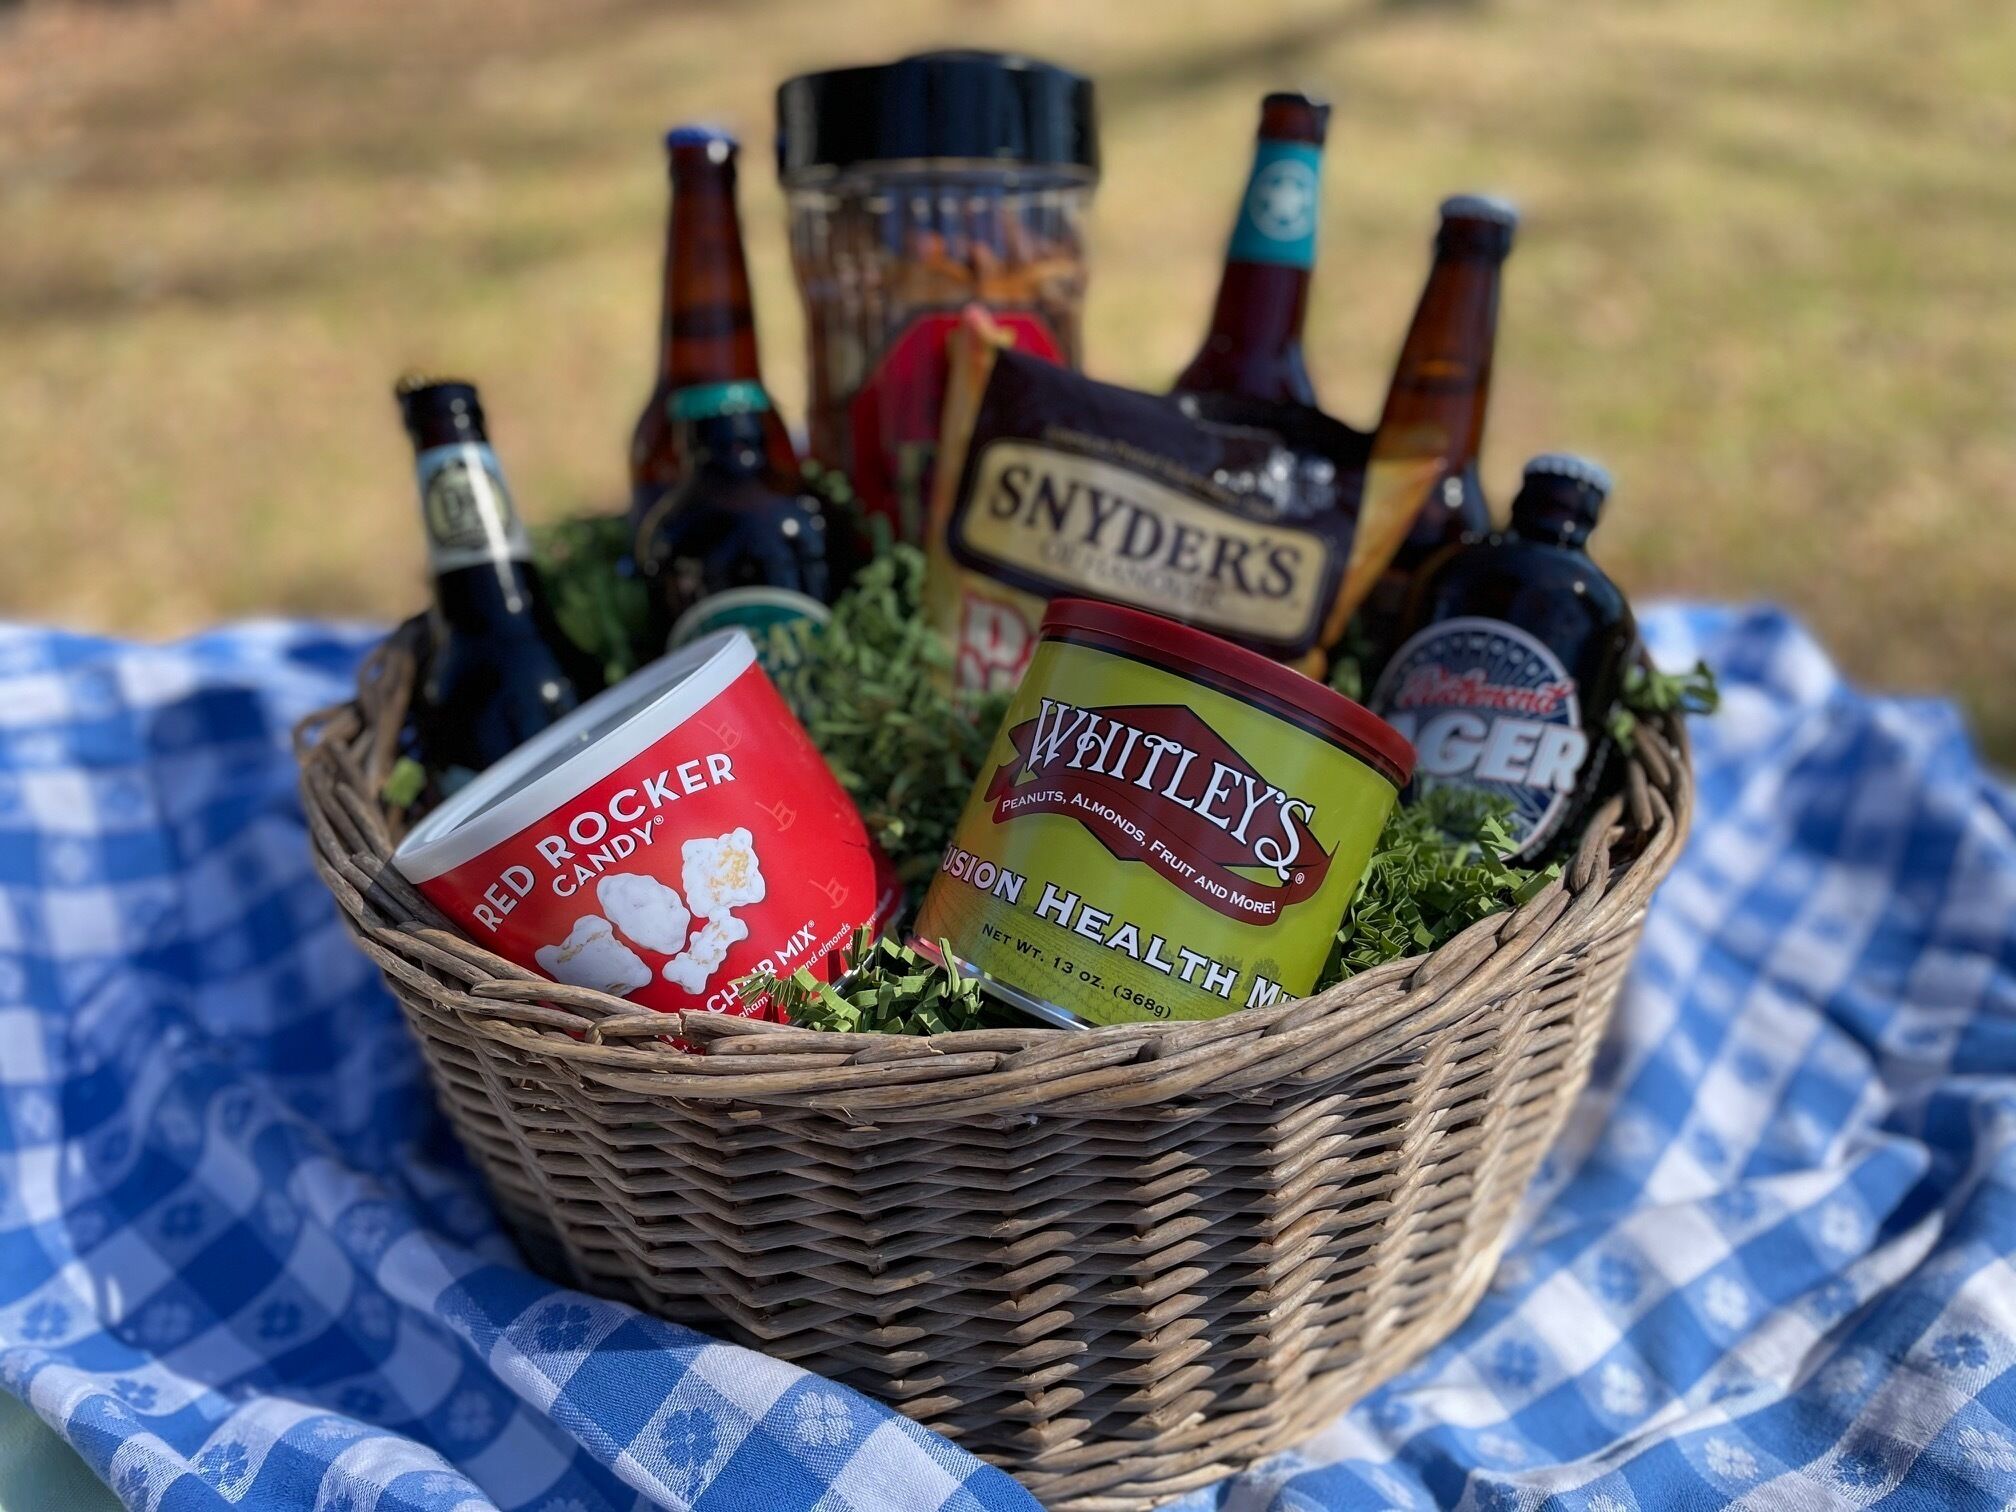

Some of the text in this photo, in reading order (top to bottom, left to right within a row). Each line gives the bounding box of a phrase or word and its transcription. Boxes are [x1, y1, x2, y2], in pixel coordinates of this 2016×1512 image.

[988, 462, 1304, 599] SNYDER'S
[1025, 697, 1316, 881] WHITLEY'S
[1385, 710, 1589, 796] GER
[472, 753, 736, 933] RED ROCKER
[1001, 790, 1276, 914] PEANUTS, ALMONDS, FRUIT AND MORE!
[738, 996, 768, 1018] aham
[818, 922, 852, 958] almonds
[942, 845, 1240, 1000] USION HEALTH
[982, 923, 1012, 945] NET
[1016, 938, 1044, 962] WT.
[1053, 957, 1074, 974] 13
[1113, 985, 1171, 1018] (368g)
